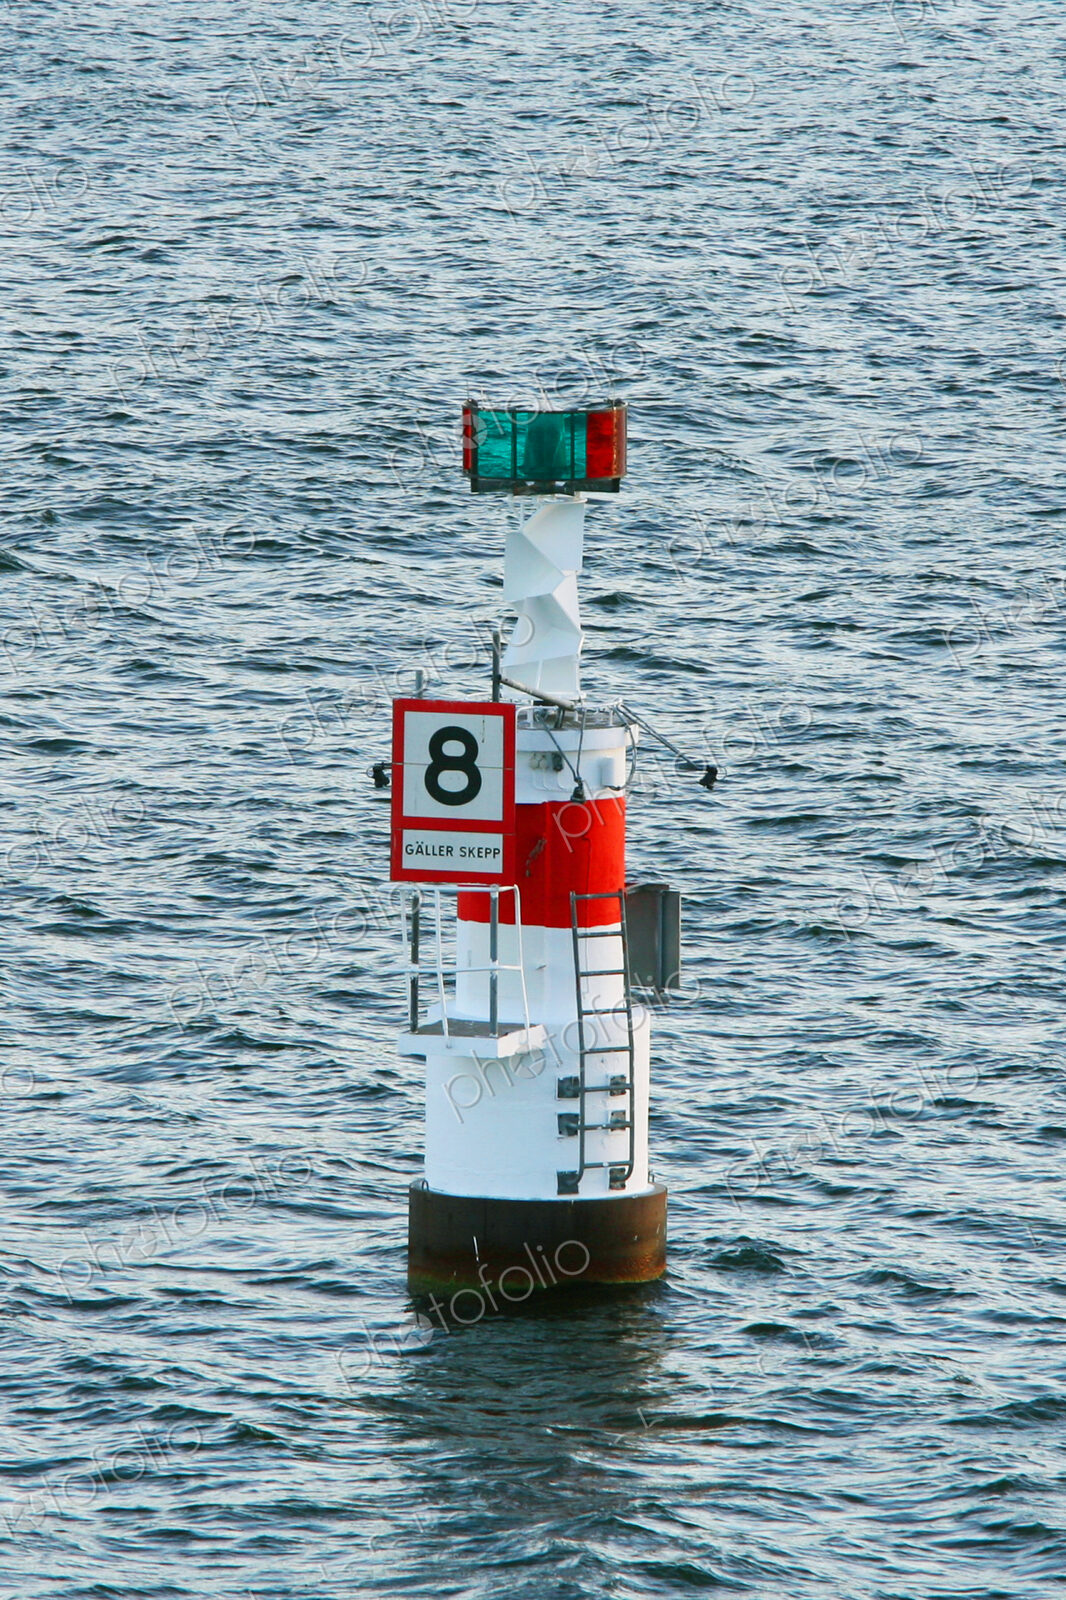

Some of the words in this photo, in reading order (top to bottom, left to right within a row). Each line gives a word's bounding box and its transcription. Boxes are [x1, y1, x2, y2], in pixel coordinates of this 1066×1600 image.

[424, 726, 482, 806] 8
[405, 841, 454, 857] GÄLLER
[459, 846, 501, 859] SKEPP
